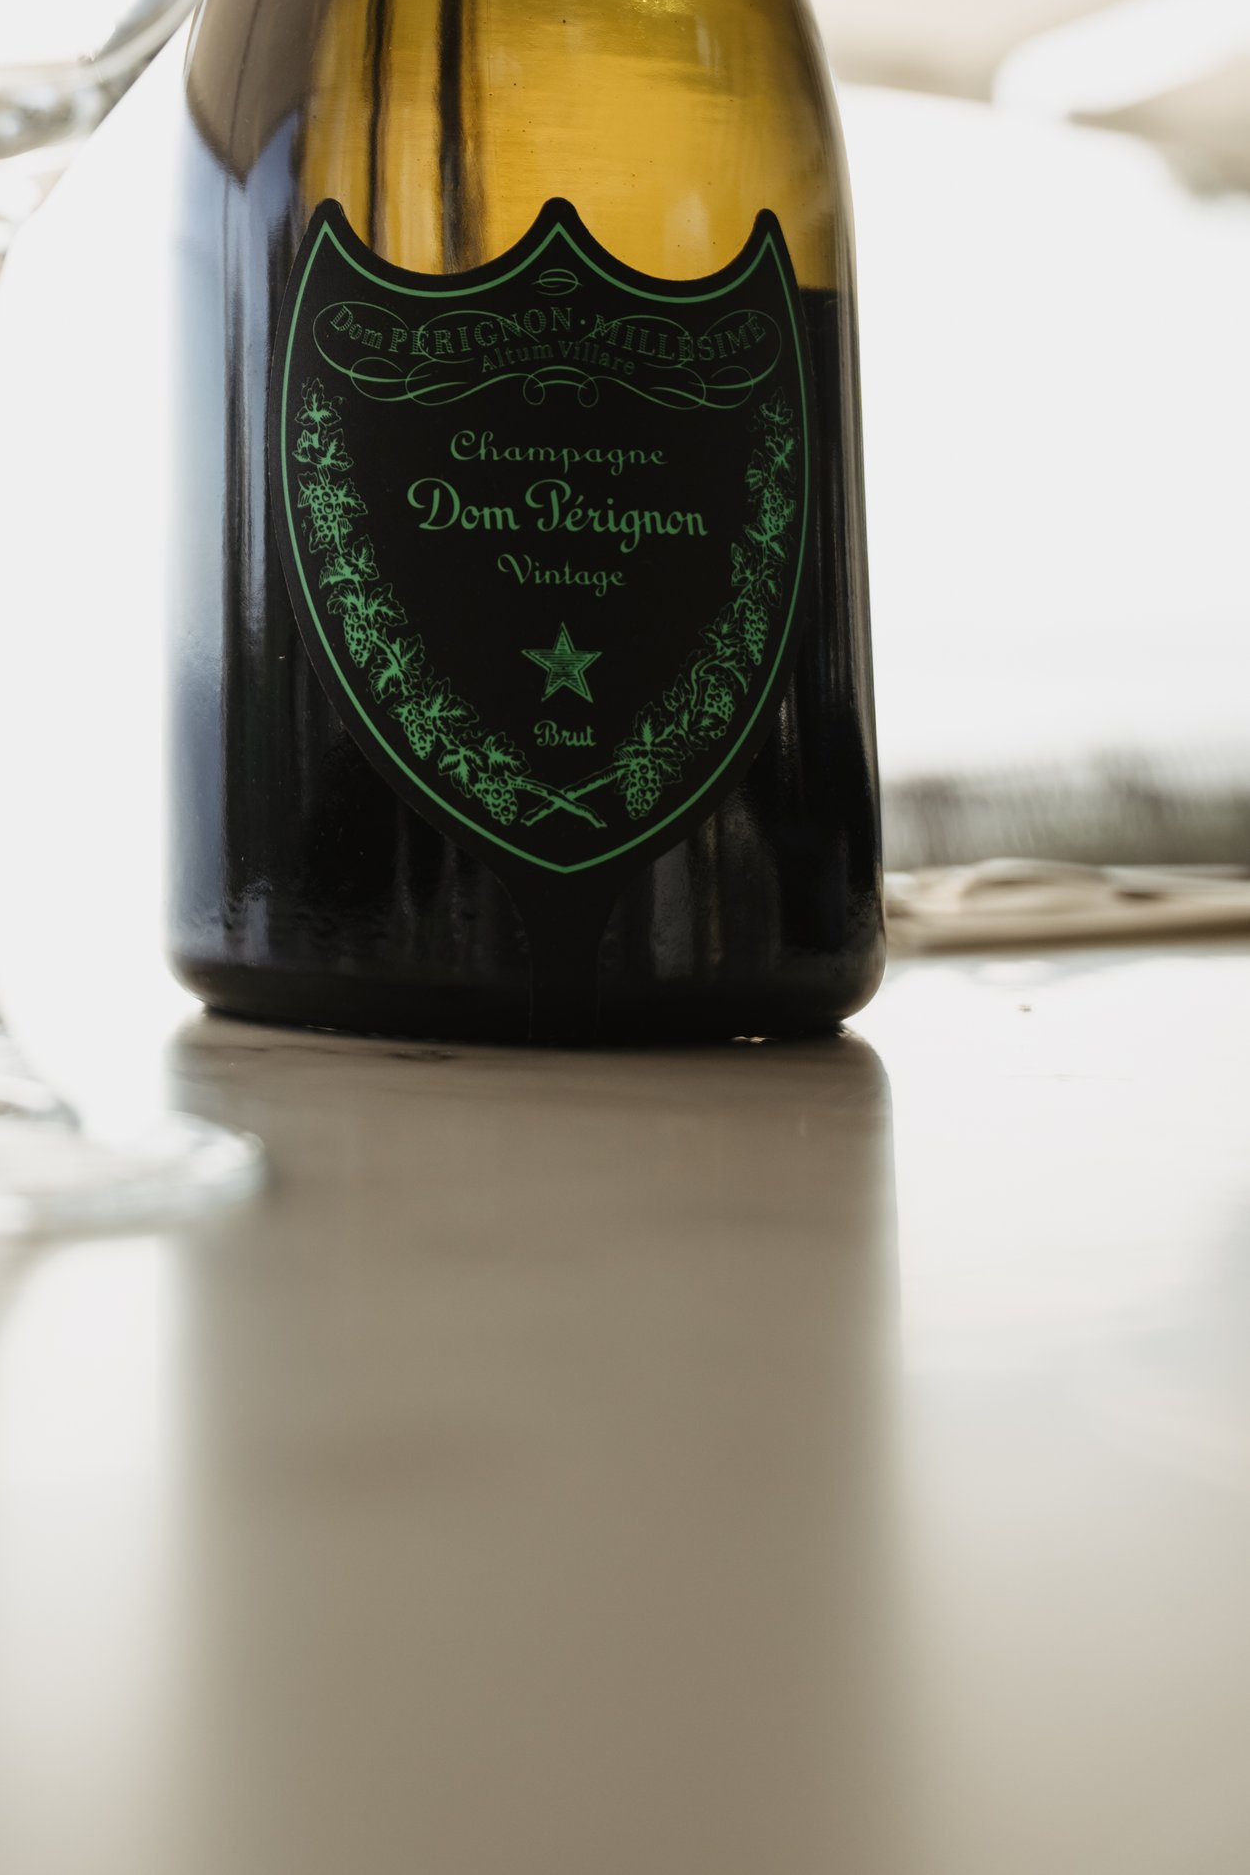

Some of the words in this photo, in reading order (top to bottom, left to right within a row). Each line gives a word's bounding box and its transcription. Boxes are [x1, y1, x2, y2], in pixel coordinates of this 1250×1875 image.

[330, 304, 382, 350] Dom
[481, 342, 554, 373] Altum
[557, 340, 636, 375] Villare
[450, 430, 668, 475] Champagne
[407, 477, 521, 530] Dom
[525, 479, 708, 553] Pérignon
[497, 553, 627, 597] Vintage
[533, 719, 598, 747] Brut
